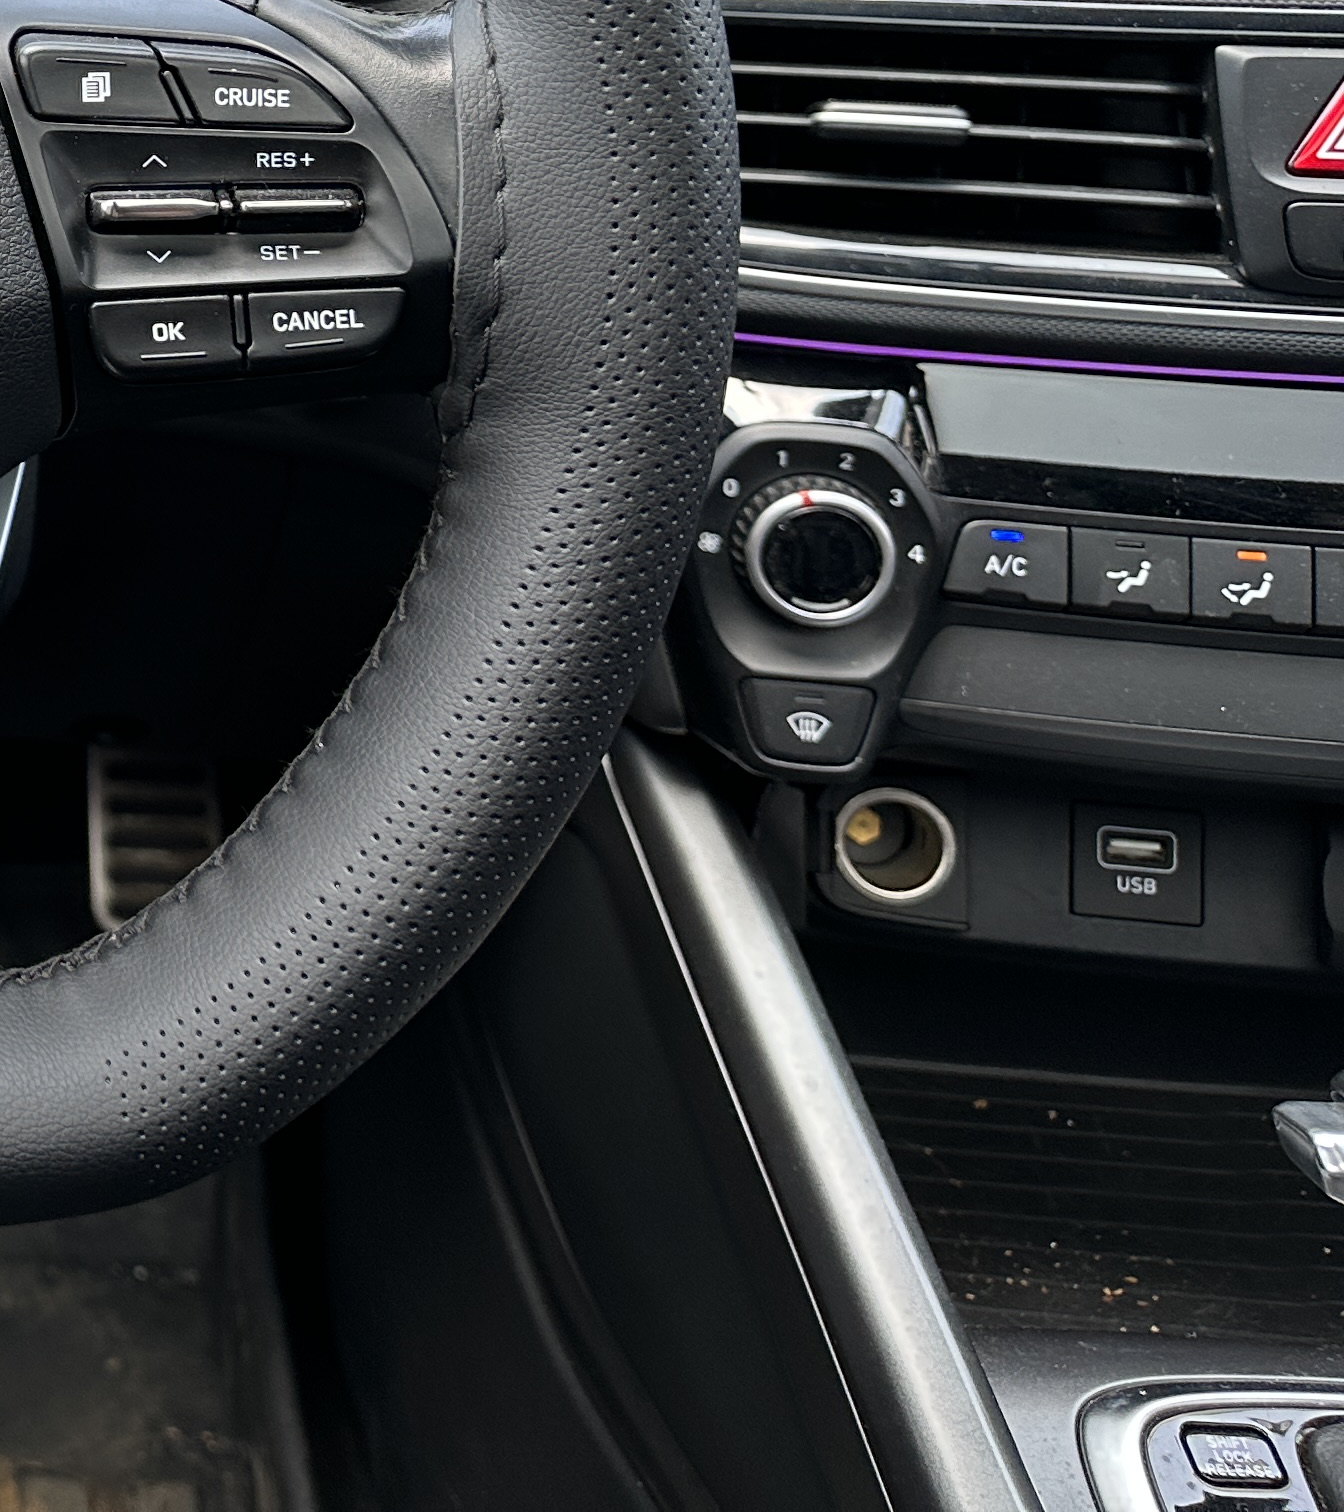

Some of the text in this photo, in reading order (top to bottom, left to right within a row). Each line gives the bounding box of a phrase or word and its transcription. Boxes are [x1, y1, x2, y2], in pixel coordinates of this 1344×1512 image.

[215, 88, 290, 107] CRUISE
[273, 309, 365, 332] CANCEL
[152, 322, 186, 341] OK
[778, 451, 787, 467] 1
[840, 453, 853, 470] 2
[723, 479, 739, 497] 0
[890, 488, 907, 507] 3
[908, 545, 924, 563] 4
[985, 555, 1027, 576] A/C
[1116, 875, 1157, 895] USB
[1207, 1436, 1249, 1450] SHIFT
[1212, 1449, 1255, 1463] LOCK
[1205, 1462, 1274, 1478] RELEASE
